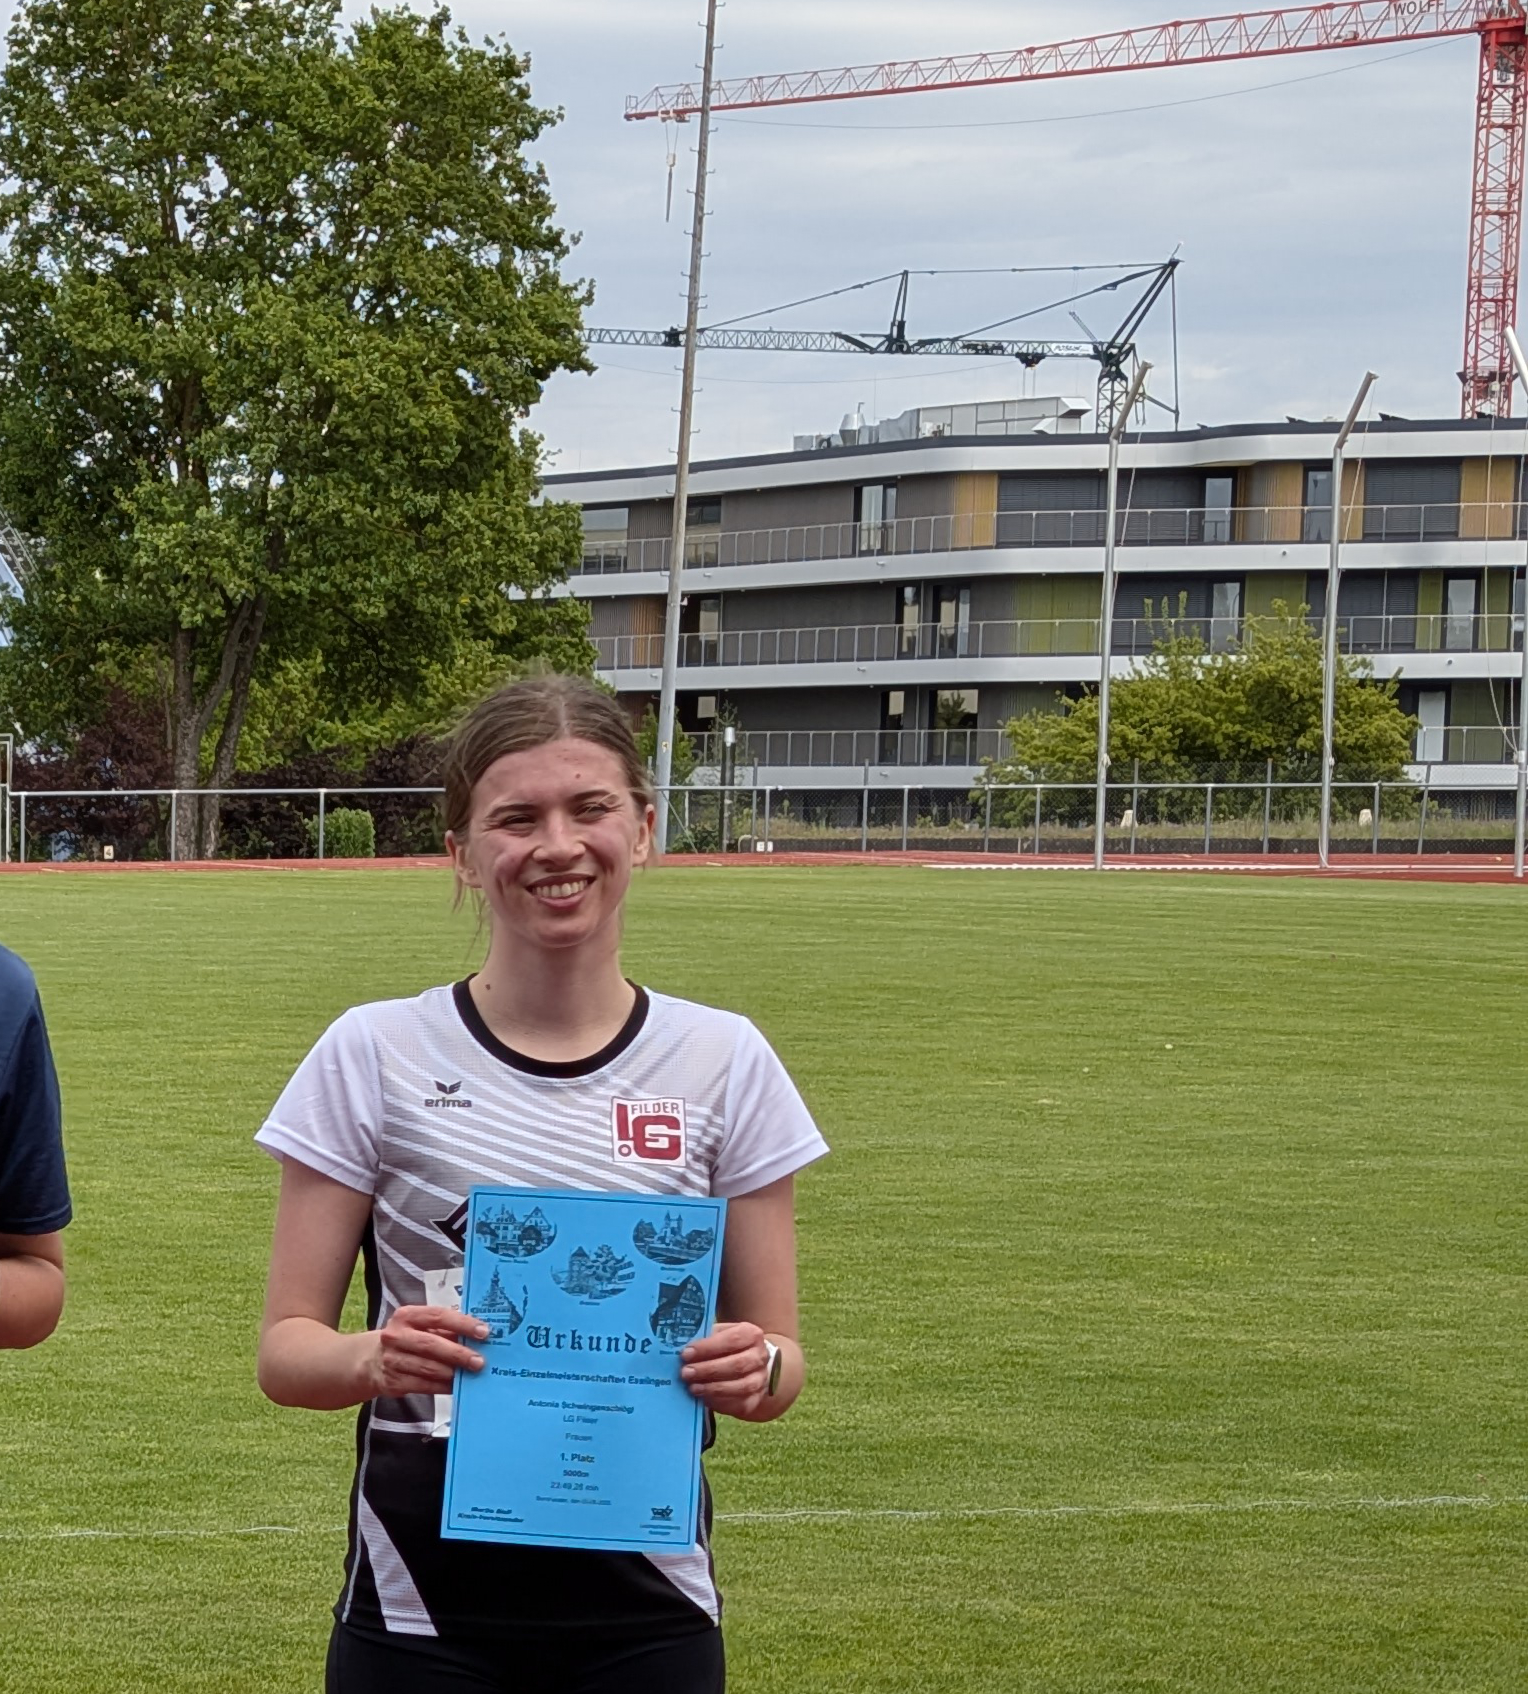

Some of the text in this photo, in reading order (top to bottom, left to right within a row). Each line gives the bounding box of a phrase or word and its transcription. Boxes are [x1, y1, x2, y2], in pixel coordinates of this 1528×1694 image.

[1394, 1, 1444, 16] WOLFF
[424, 1097, 472, 1108] erima
[631, 1102, 680, 1115] FILDER
[526, 1325, 653, 1355] Urkunde
[570, 1453, 595, 1463] Platz
